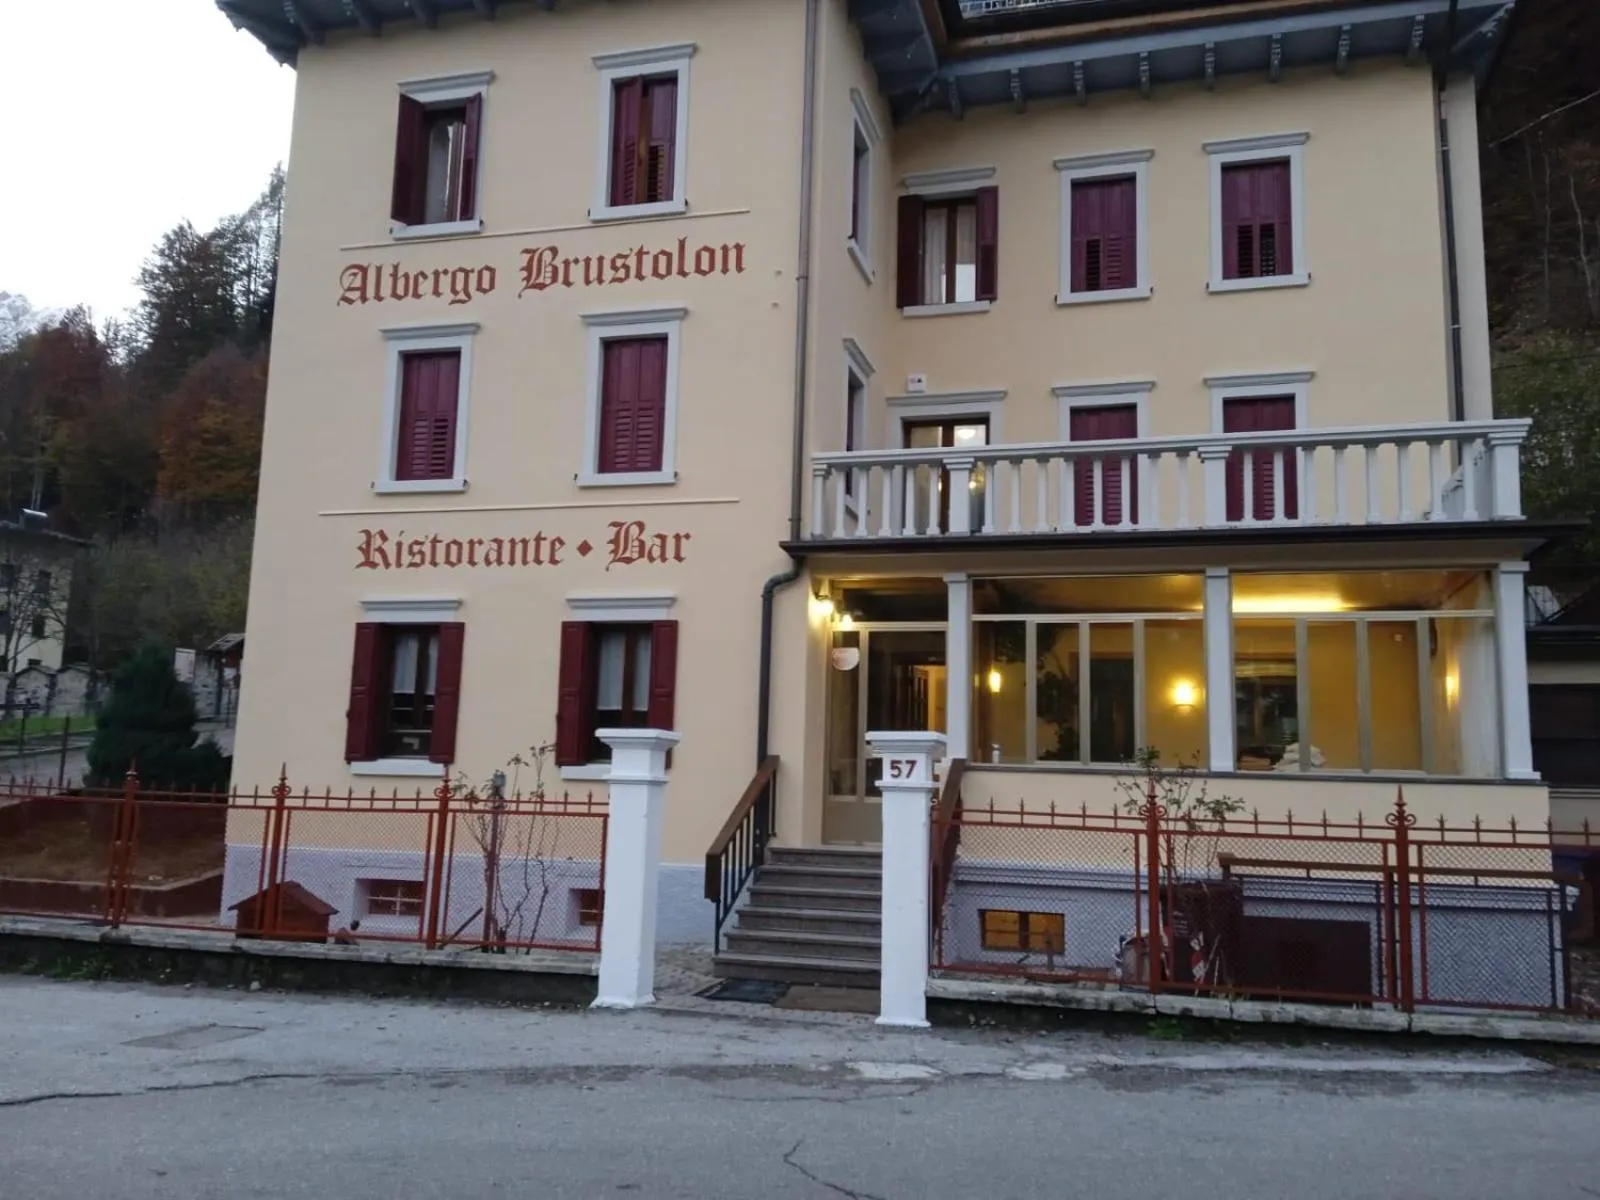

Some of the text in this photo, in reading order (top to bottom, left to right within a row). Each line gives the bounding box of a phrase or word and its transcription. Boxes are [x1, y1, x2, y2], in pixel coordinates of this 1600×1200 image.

[337, 236, 746, 306] Albergo Brustolon
[355, 520, 691, 572] Ristorante Bar
[890, 759, 917, 779] 57
